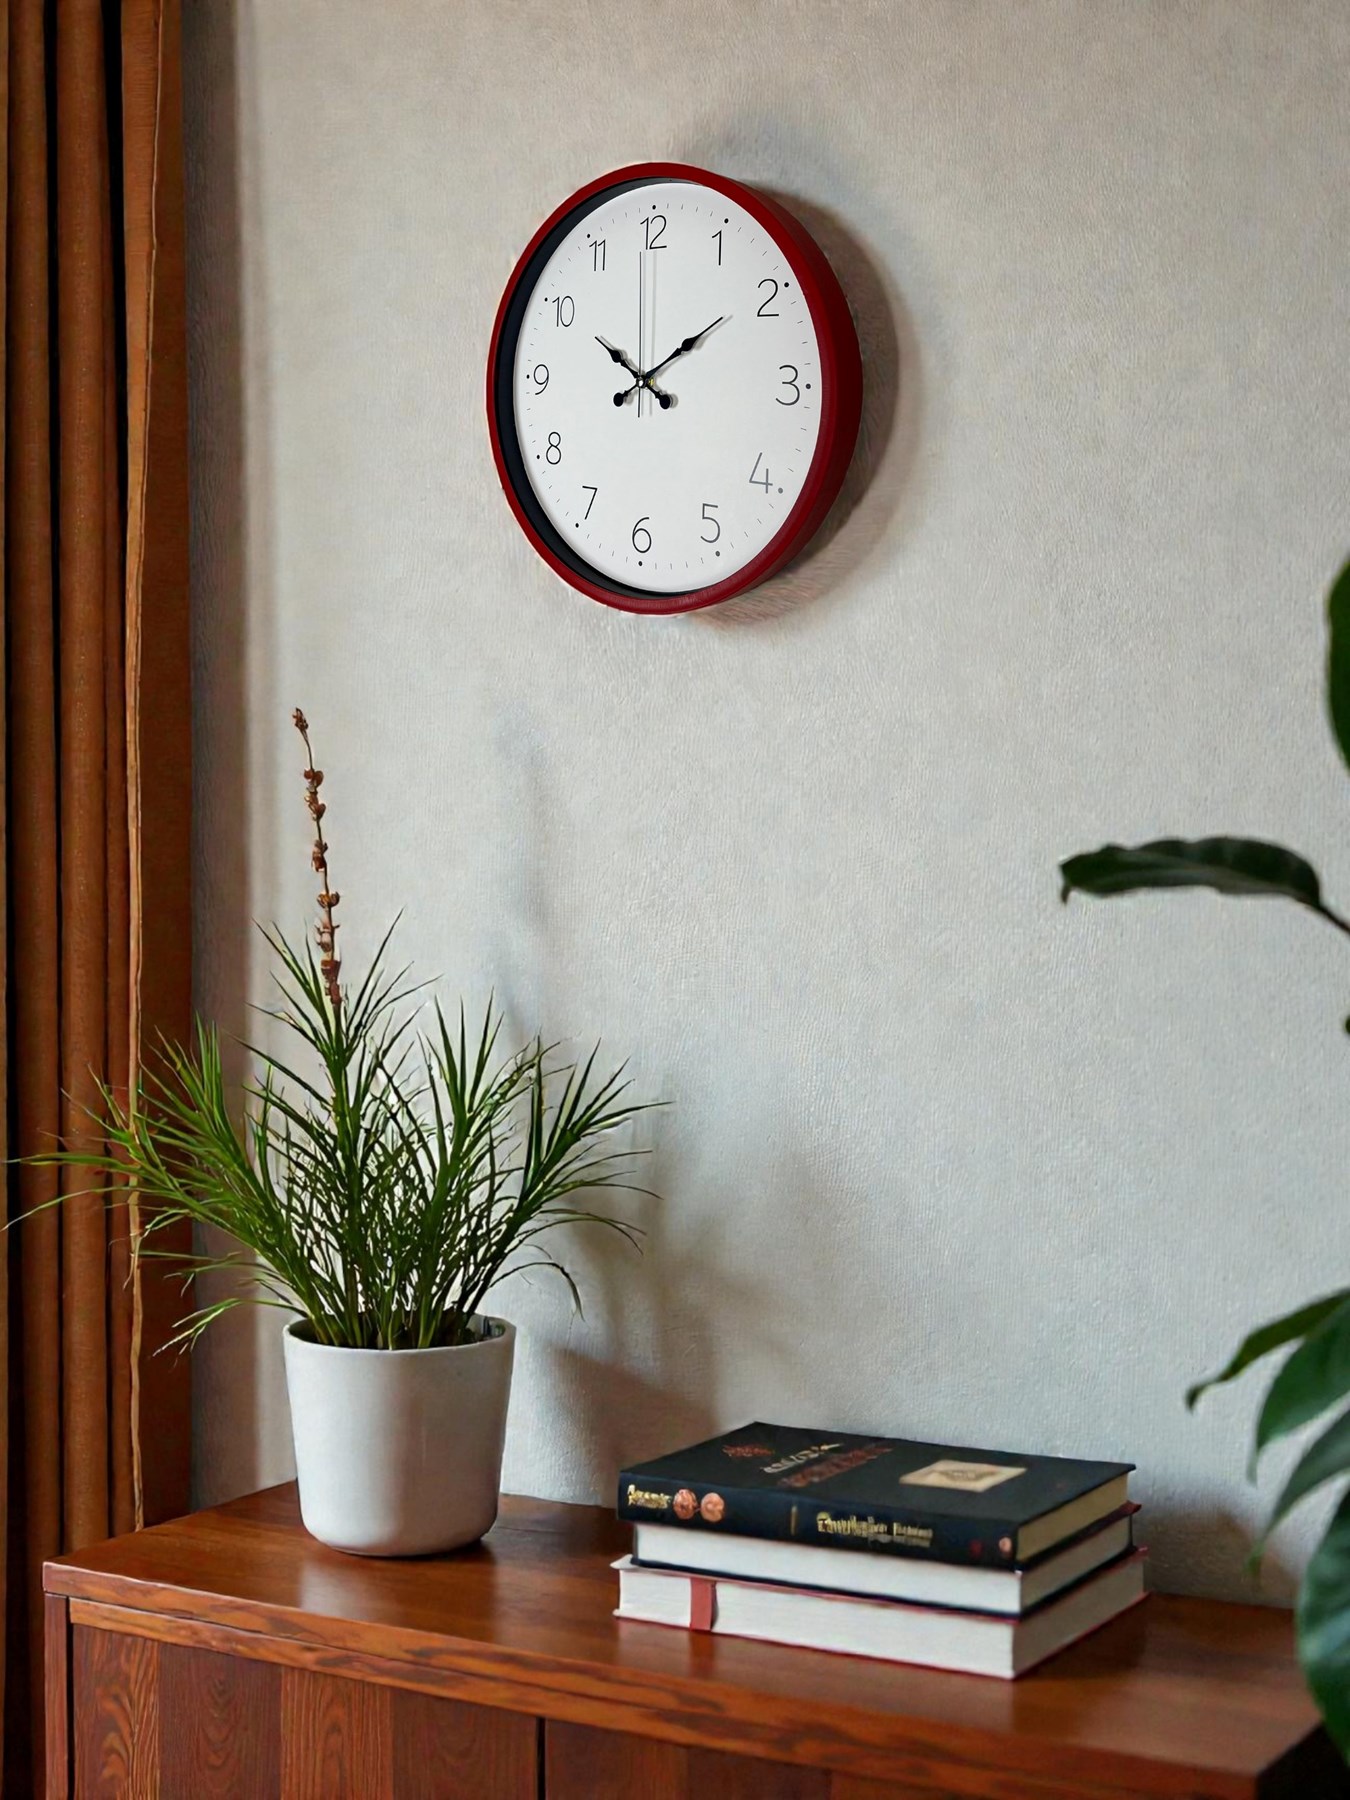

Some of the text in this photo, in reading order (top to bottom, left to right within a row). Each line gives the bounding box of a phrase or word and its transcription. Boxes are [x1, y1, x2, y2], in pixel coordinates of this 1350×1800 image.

[640, 215, 667, 252] 12
[712, 229, 722, 266] 1
[589, 239, 606, 271] 11
[552, 296, 575, 327] 10
[757, 279, 779, 317] 2
[533, 364, 549, 395] 9
[776, 365, 800, 406] 3
[546, 432, 561, 465] 8
[749, 452, 773, 494] 4
[582, 486, 598, 520] 7
[632, 517, 652, 553] 6
[701, 503, 720, 543] 5
